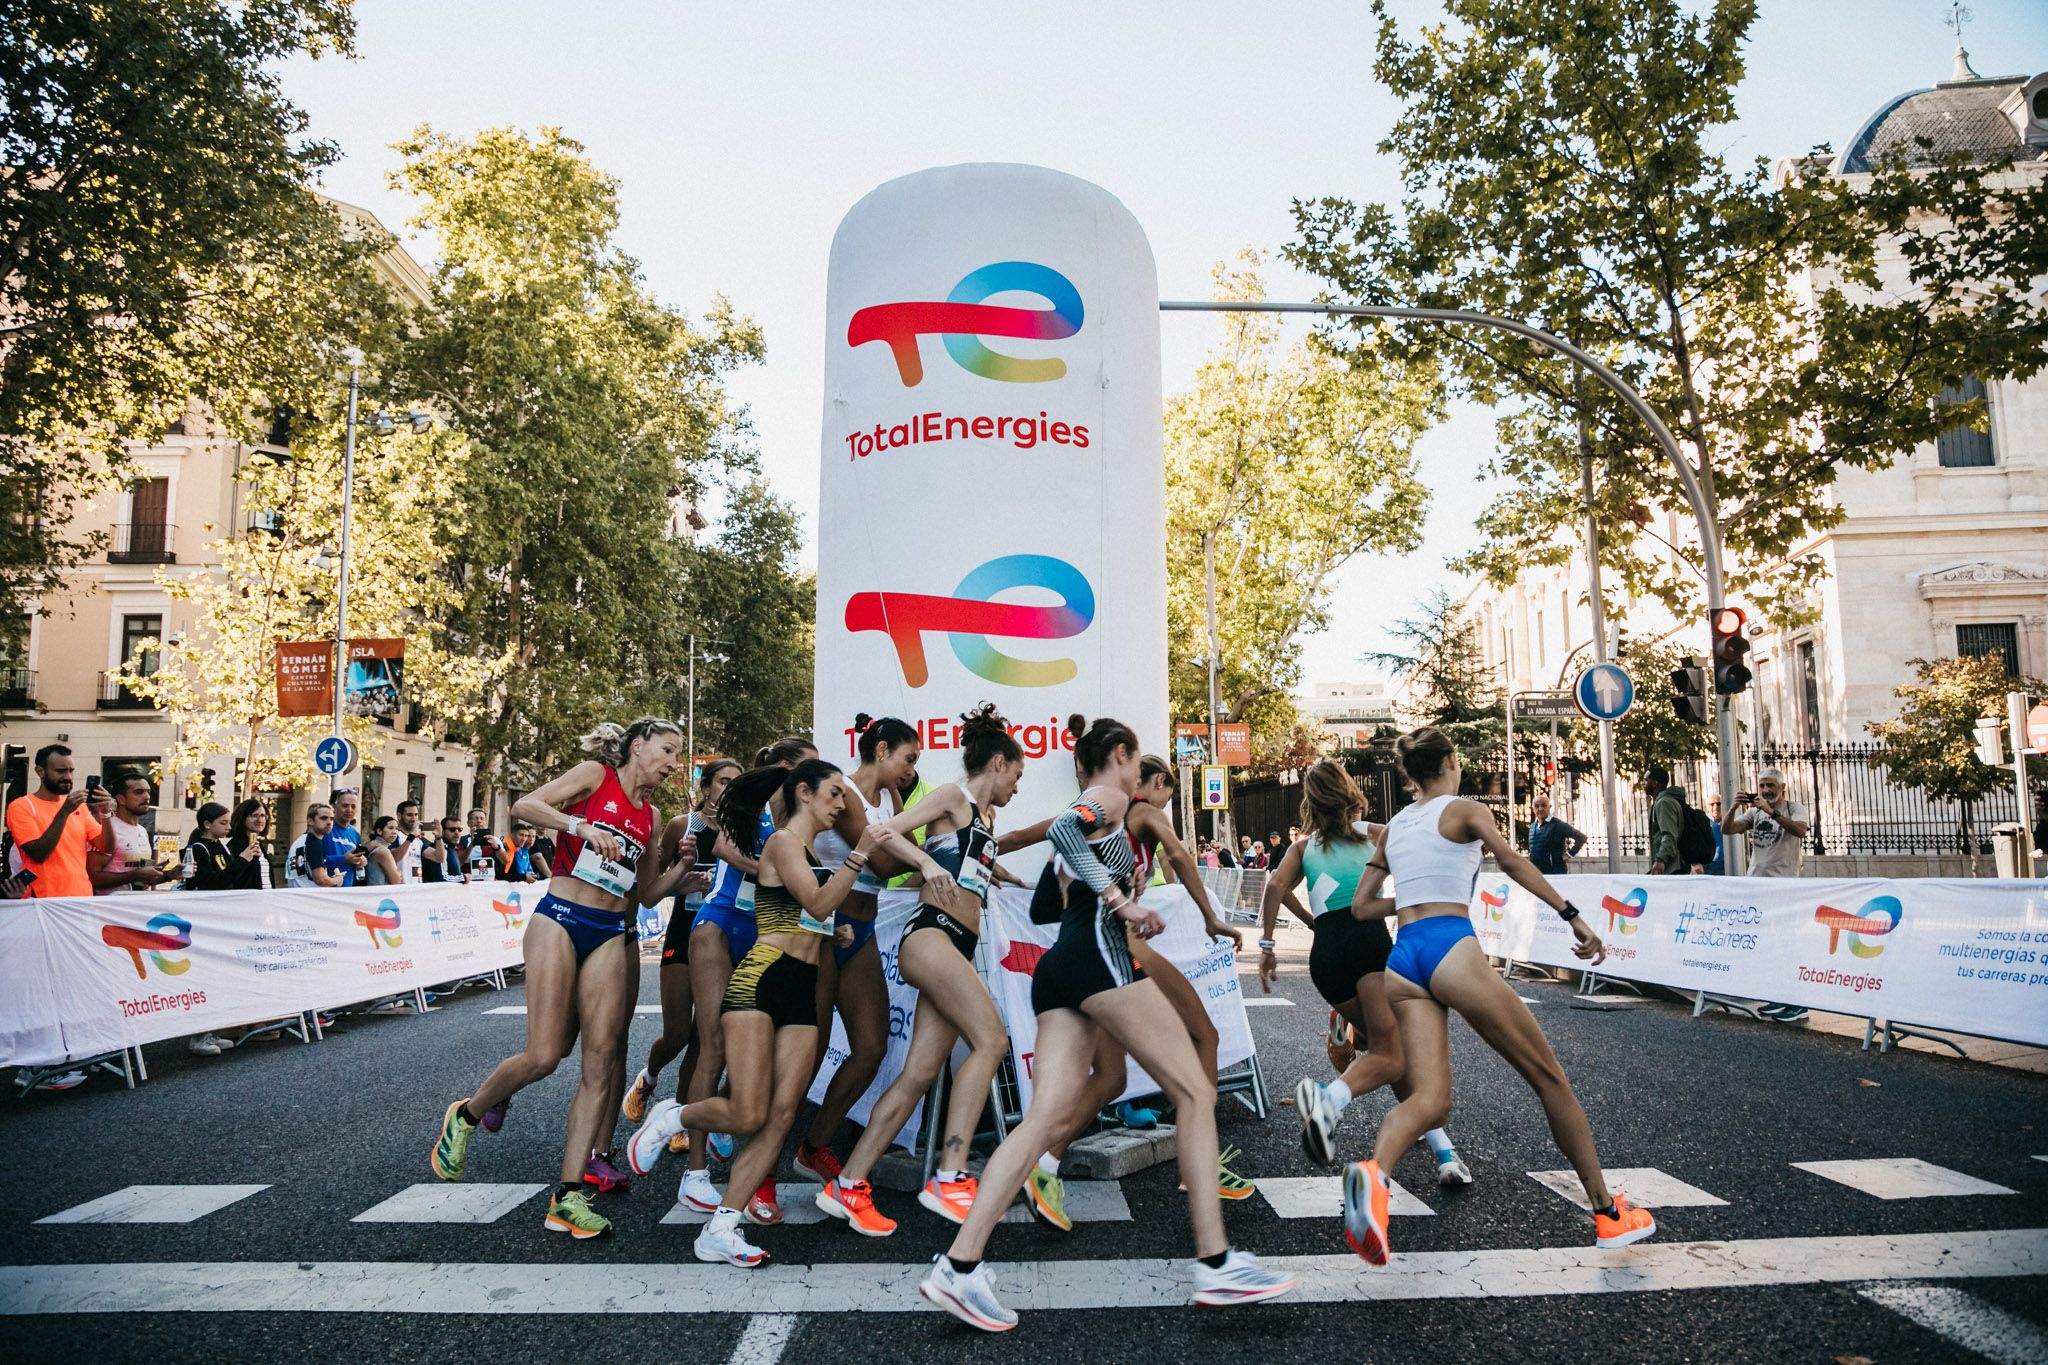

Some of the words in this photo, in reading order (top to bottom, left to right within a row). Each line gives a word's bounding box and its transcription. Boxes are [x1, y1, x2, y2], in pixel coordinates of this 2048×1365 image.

[846, 411, 1089, 461] TotalEnergies
[281, 655, 326, 664] FERNÁN
[352, 648, 375, 656] ISLA
[1558, 706, 1577, 714] ESPAÑO
[600, 862, 620, 878] ISABEL
[551, 903, 571, 914] ADM
[1691, 927, 1758, 950] LasCarreras
[1977, 929, 2017, 941] Somos
[2020, 931, 2031, 942] la
[1939, 943, 2036, 964] multienergías
[365, 958, 413, 975] TotalEnergies
[1683, 957, 1731, 972] totalenergies.es
[1799, 966, 1883, 992] TotalEnergies
[1957, 966, 1974, 978] tus
[1978, 969, 2027, 983] carreras
[1208, 984, 1225, 998] tus
[119, 989, 207, 1018] TotalEnergies
